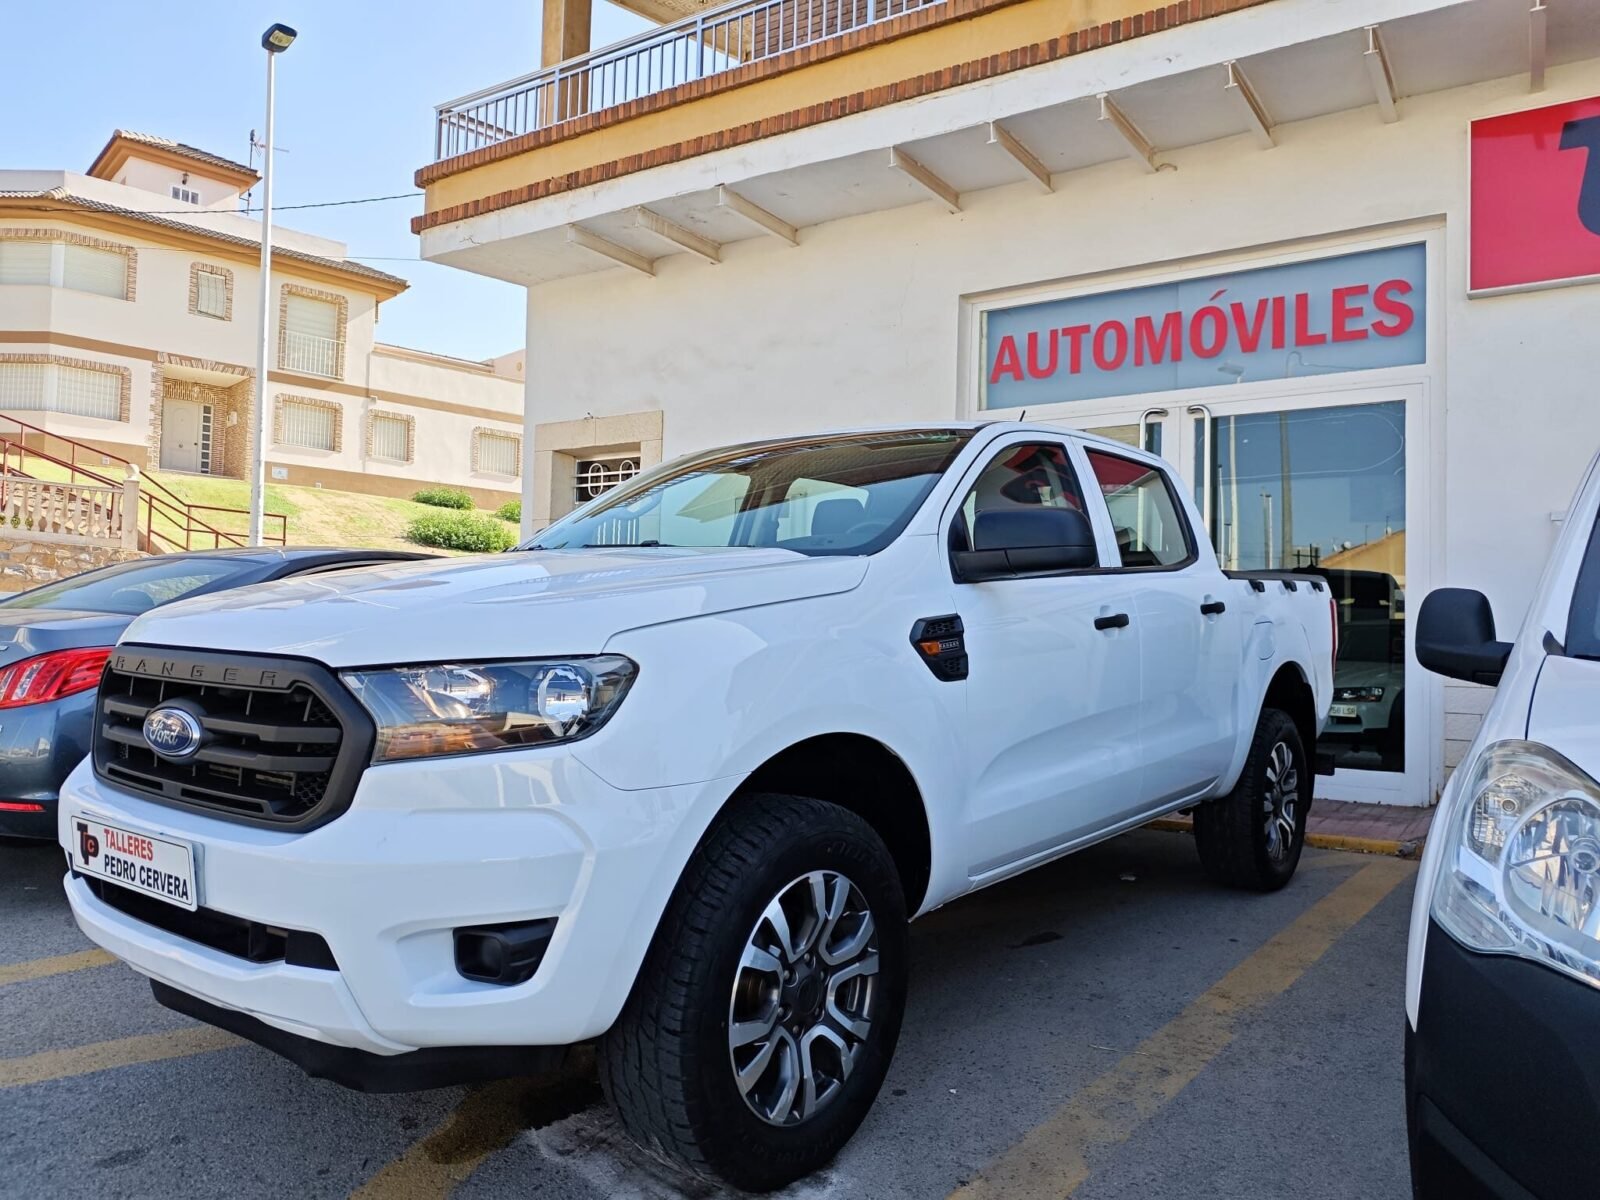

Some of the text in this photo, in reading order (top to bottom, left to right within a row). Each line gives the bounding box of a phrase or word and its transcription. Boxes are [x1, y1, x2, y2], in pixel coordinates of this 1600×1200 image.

[990, 279, 1414, 384] AUTOMÓVILES
[115, 655, 278, 686] RANGER
[149, 716, 180, 745] Ford
[104, 828, 154, 862] TALLERES
[104, 854, 189, 900] PEDRO CERVERA
